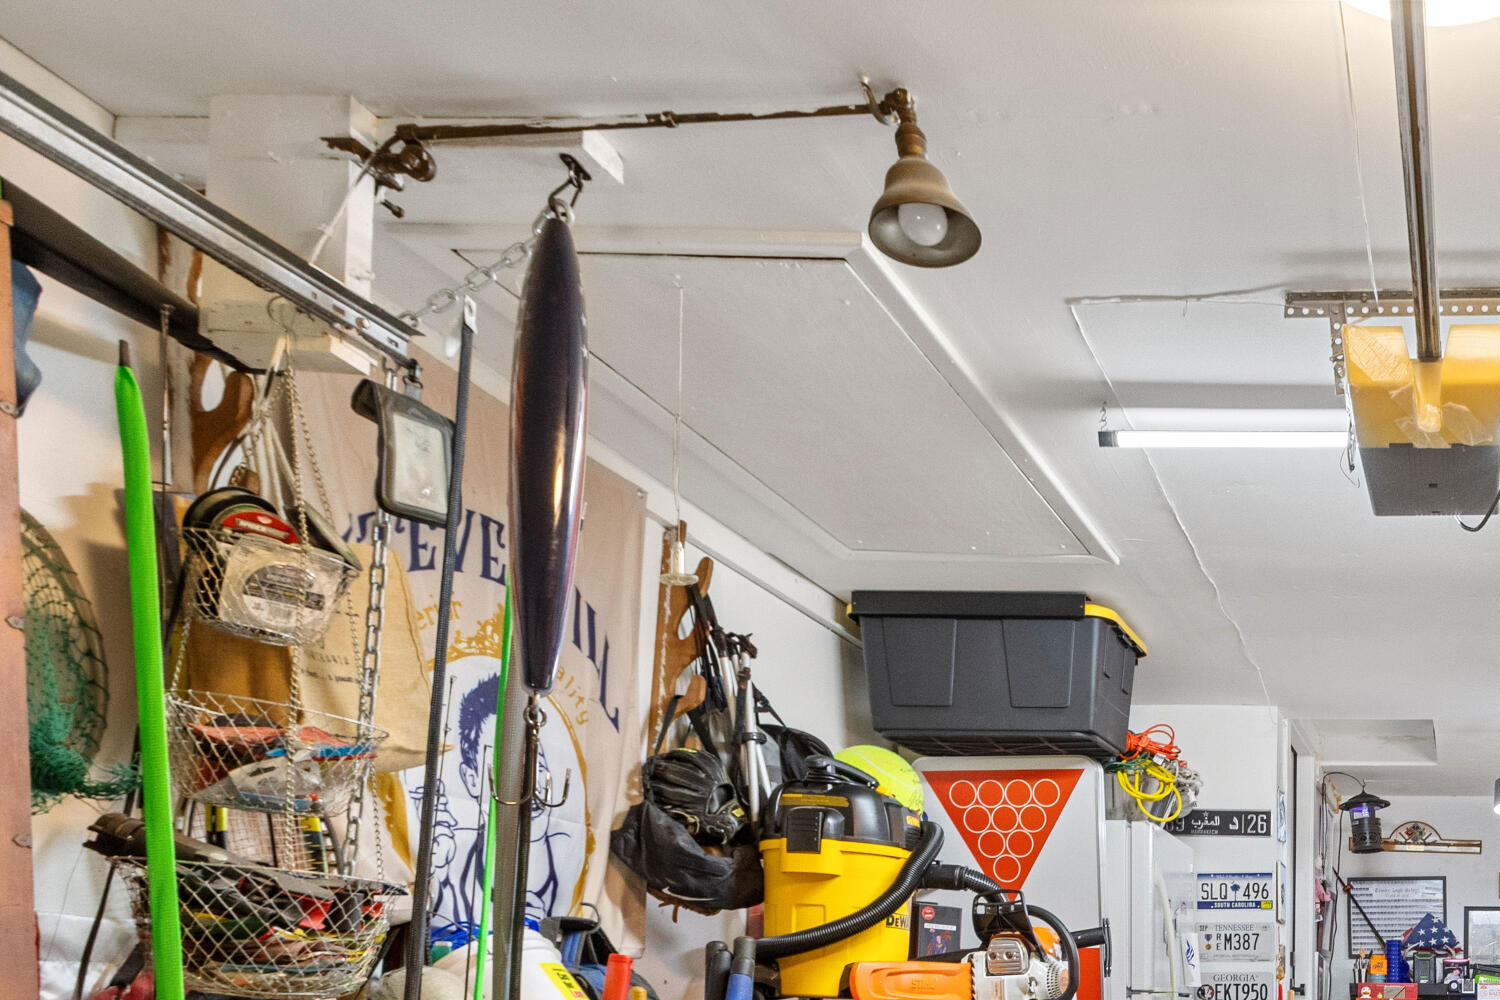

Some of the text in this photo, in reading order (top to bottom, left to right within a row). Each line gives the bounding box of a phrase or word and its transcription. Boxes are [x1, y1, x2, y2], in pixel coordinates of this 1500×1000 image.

[1247, 814, 1267, 834] 26
[1201, 882, 1269, 900] SLQ 496
[1224, 933, 1260, 951] M387
[1213, 974, 1256, 982] GEORGIA
